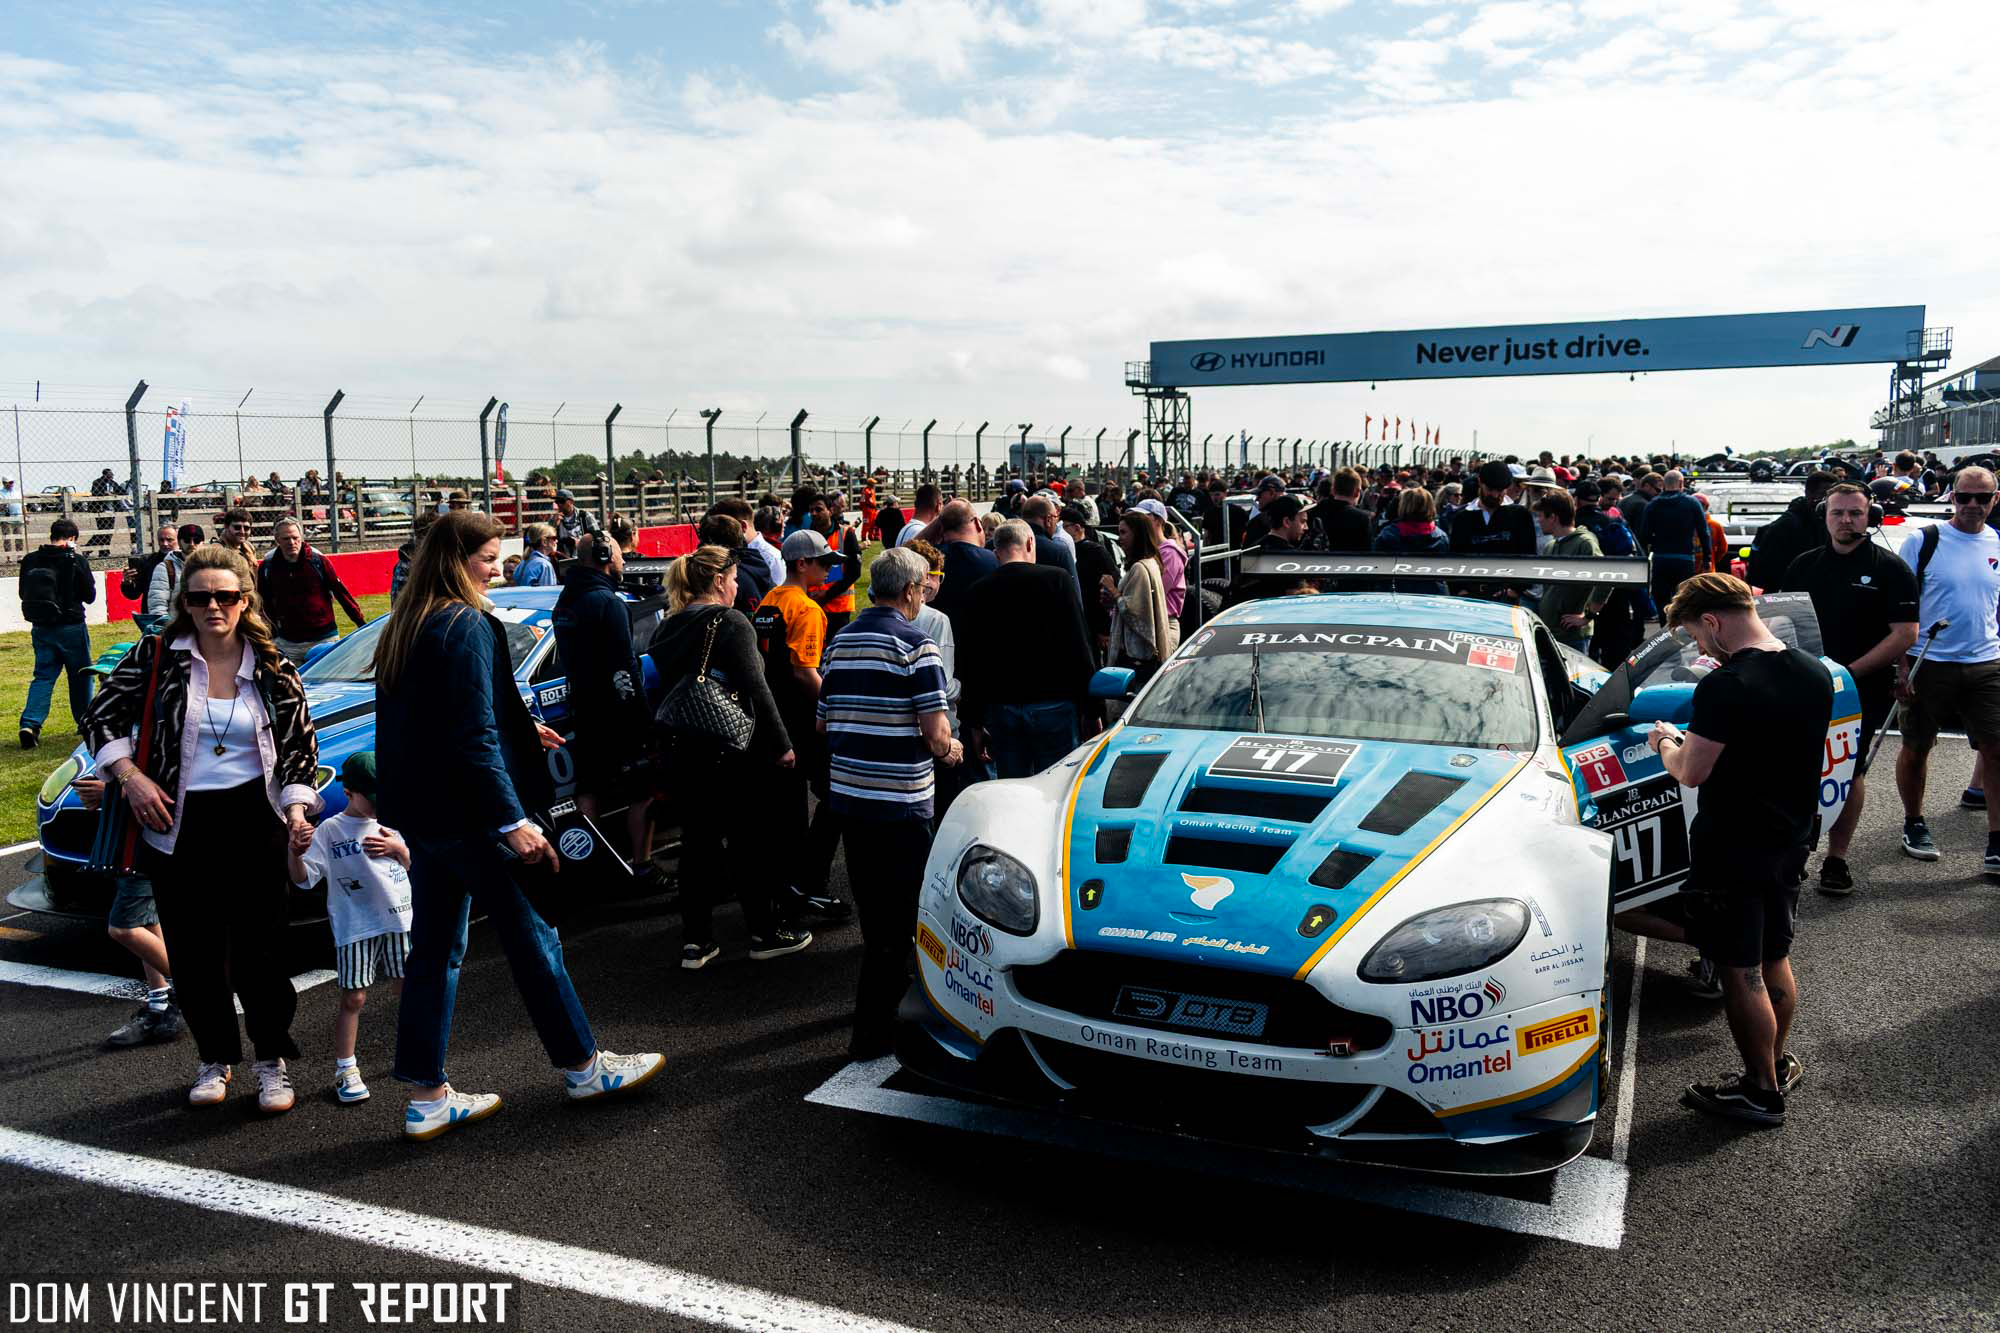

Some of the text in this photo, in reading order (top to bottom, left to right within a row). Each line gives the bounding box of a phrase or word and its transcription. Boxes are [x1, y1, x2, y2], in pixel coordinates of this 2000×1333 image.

[1231, 350, 1325, 368] HYUNDAI
[1416, 334, 1649, 366] Never just drive.
[1275, 562, 1628, 580] Oman Racing Team
[1238, 632, 1459, 654] BLANCPAIN
[1452, 632, 1519, 651] PRO-AM
[1236, 741, 1350, 753] BLANCPAIN
[1575, 746, 1608, 763] GT3
[1252, 748, 1318, 772] 47
[1594, 762, 1611, 786] C
[1593, 787, 1679, 827] BLANCPAIN
[1180, 819, 1292, 836] Oman Racing Team
[331, 841, 361, 859] NYC
[1614, 816, 1662, 883] 47
[920, 928, 944, 965] PIRELLI
[951, 916, 979, 954] NBO
[1098, 927, 1177, 943] OMAN AIR
[1535, 965, 1550, 974] BARR
[1561, 957, 1584, 967] JISSAH
[945, 969, 993, 1017] Omantel
[1553, 977, 1570, 986] OMAN
[1411, 993, 1483, 1025] NBO
[1408, 1025, 1509, 1061] عمانتل
[1525, 1014, 1589, 1050] PIRELLI
[1081, 1025, 1282, 1072] Oman Racing Team
[1408, 1050, 1511, 1084] Omantel
